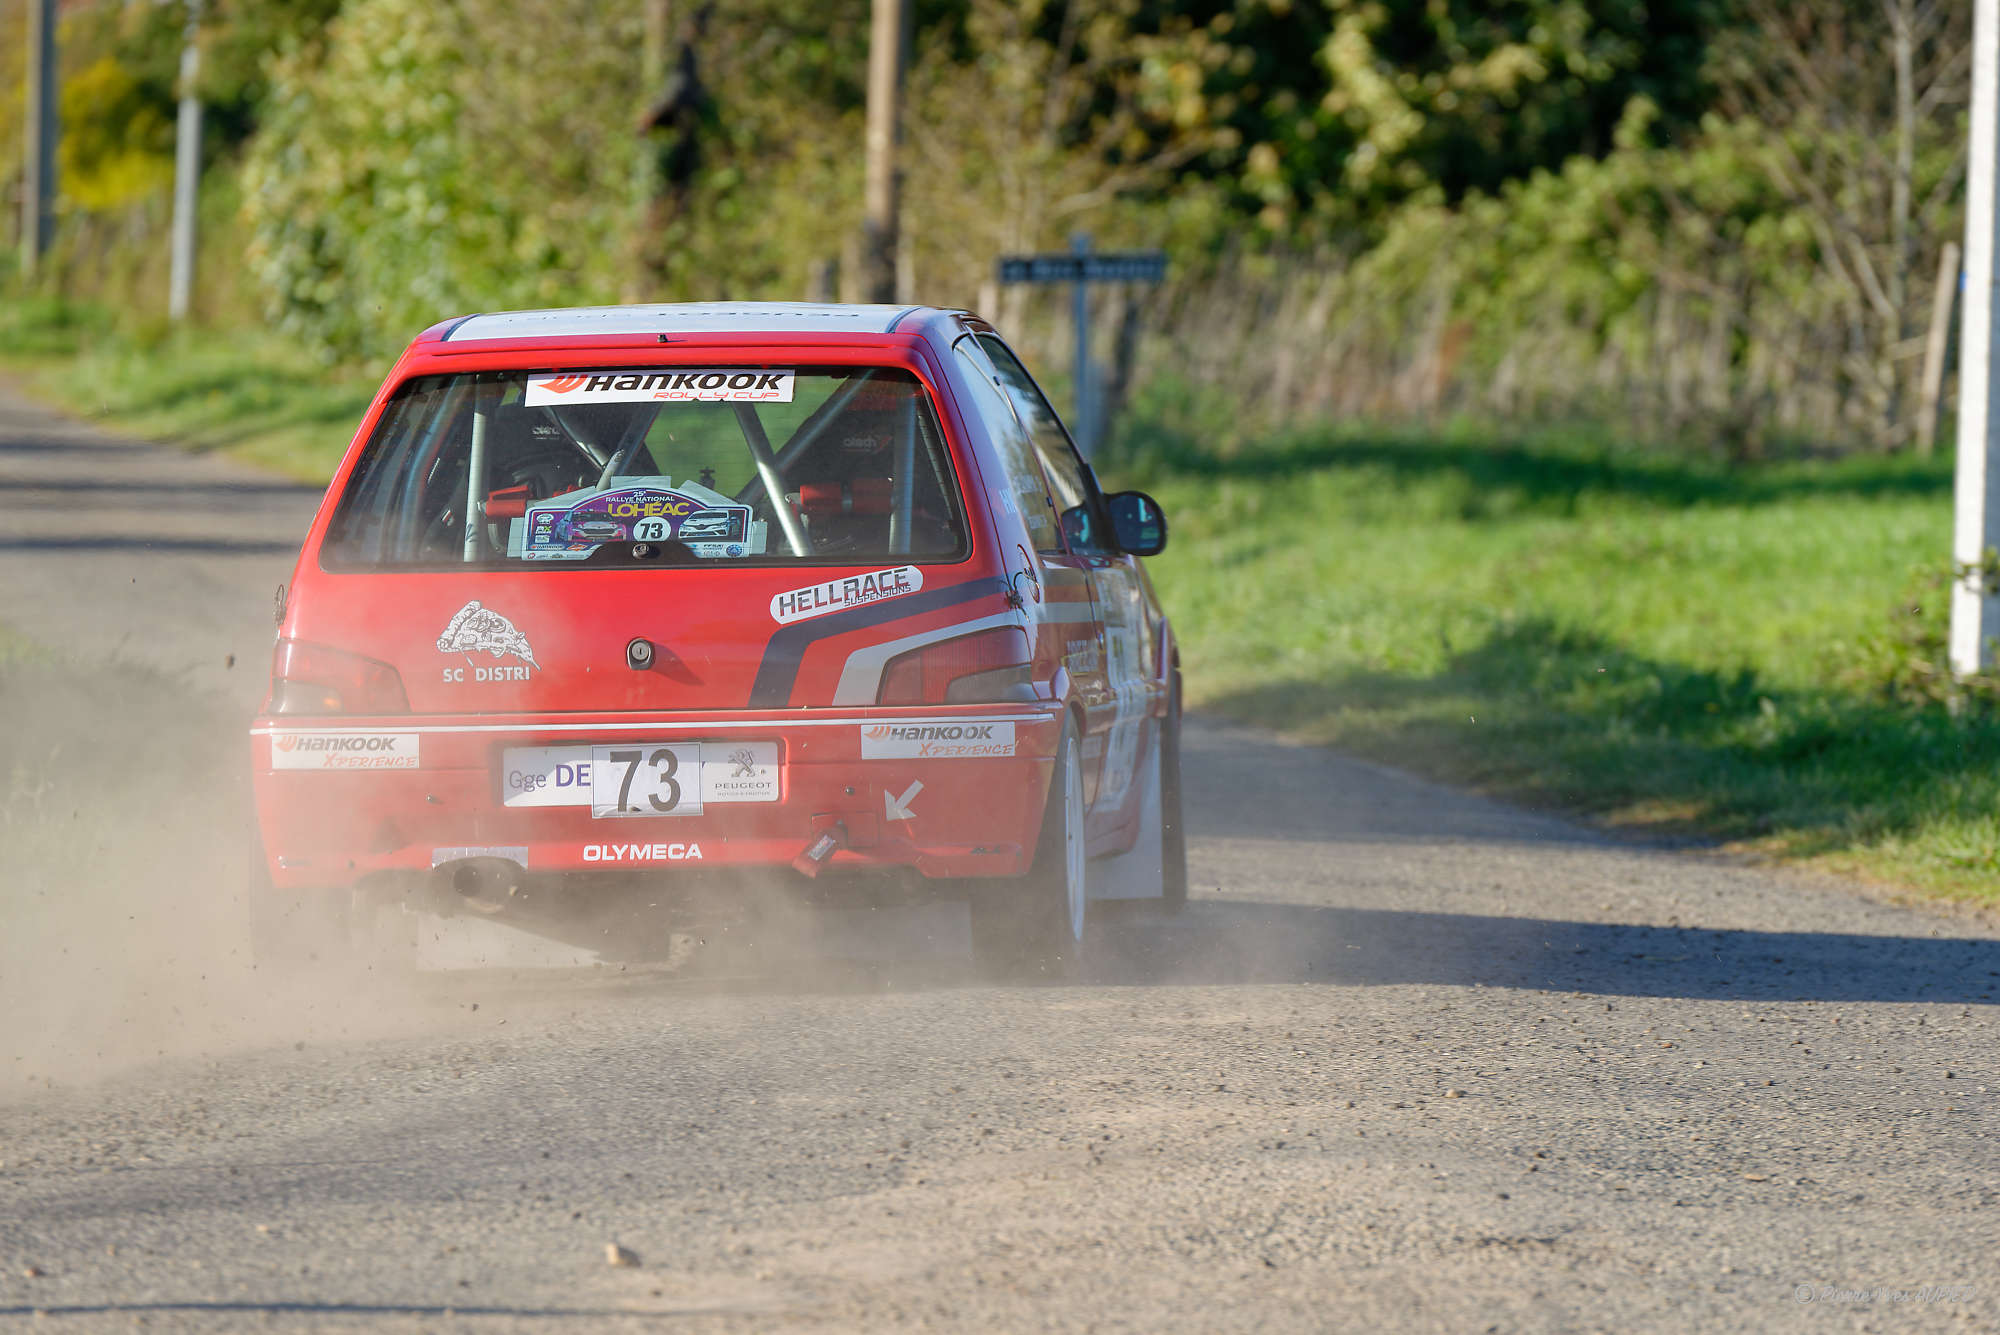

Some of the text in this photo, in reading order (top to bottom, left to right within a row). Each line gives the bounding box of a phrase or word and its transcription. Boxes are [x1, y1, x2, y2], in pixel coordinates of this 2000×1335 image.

[733, 391, 779, 399] CUP
[605, 496, 635, 504] RALLYE
[607, 501, 690, 517] LOHÉAC
[640, 522, 663, 539] 73
[779, 568, 908, 616] HELLRACE
[844, 584, 912, 607] SUSPENSIONS
[443, 666, 530, 682] SC DISTRI
[509, 770, 546, 792] Gge
[610, 748, 681, 813] 73
[583, 844, 702, 861] OLYMECA
